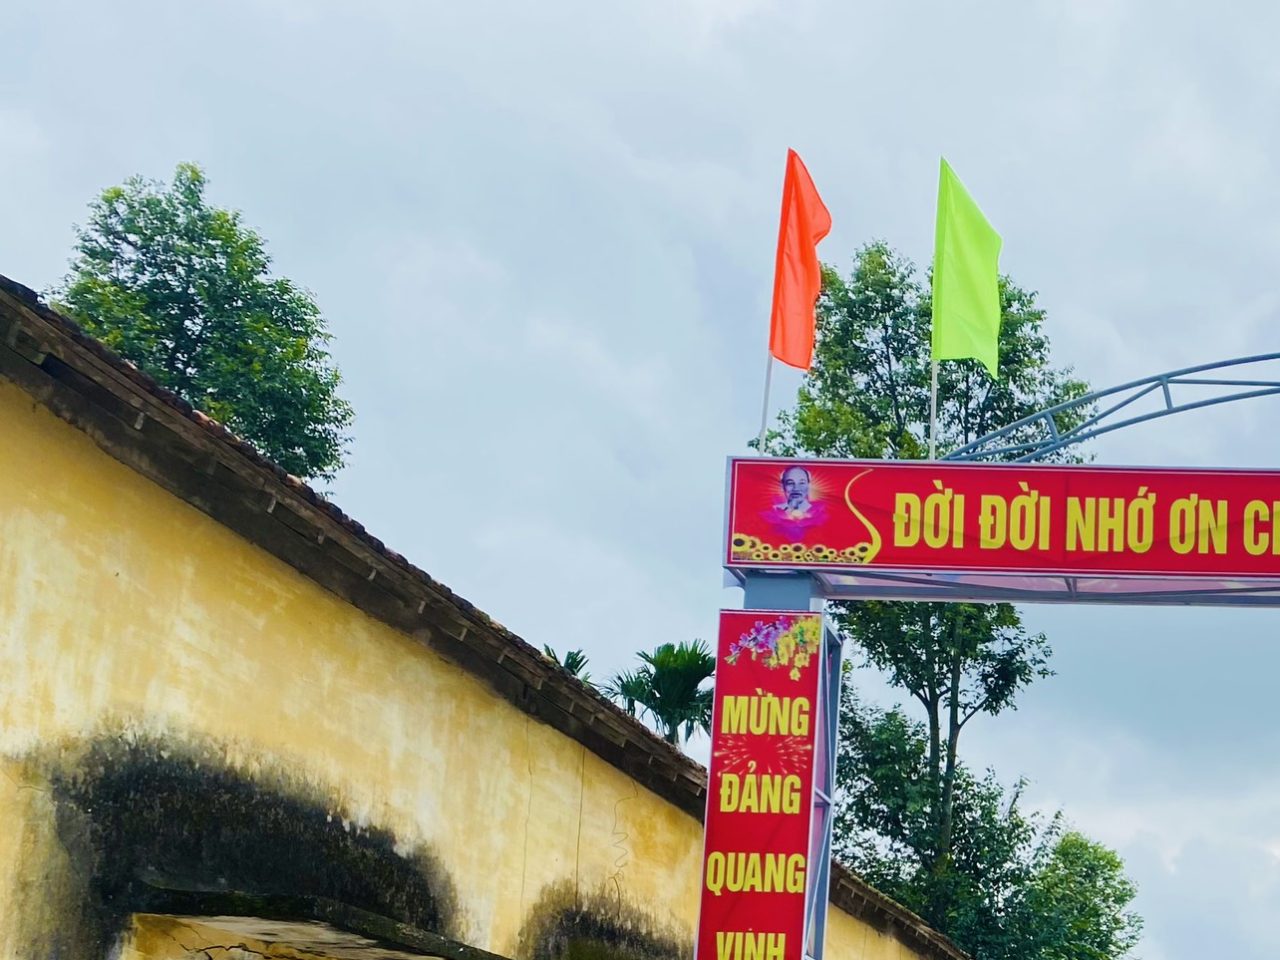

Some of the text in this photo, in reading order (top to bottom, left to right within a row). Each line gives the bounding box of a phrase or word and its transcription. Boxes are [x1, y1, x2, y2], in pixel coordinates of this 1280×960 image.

[893, 479, 964, 549] ĐỜI
[979, 481, 1051, 551] ĐỜI
[1066, 486, 1156, 553] NHỚ
[1169, 493, 1228, 555] ƠN
[721, 688, 810, 736] MỪNG
[719, 760, 802, 815] ĐẢNG
[706, 851, 806, 896] QUANG
